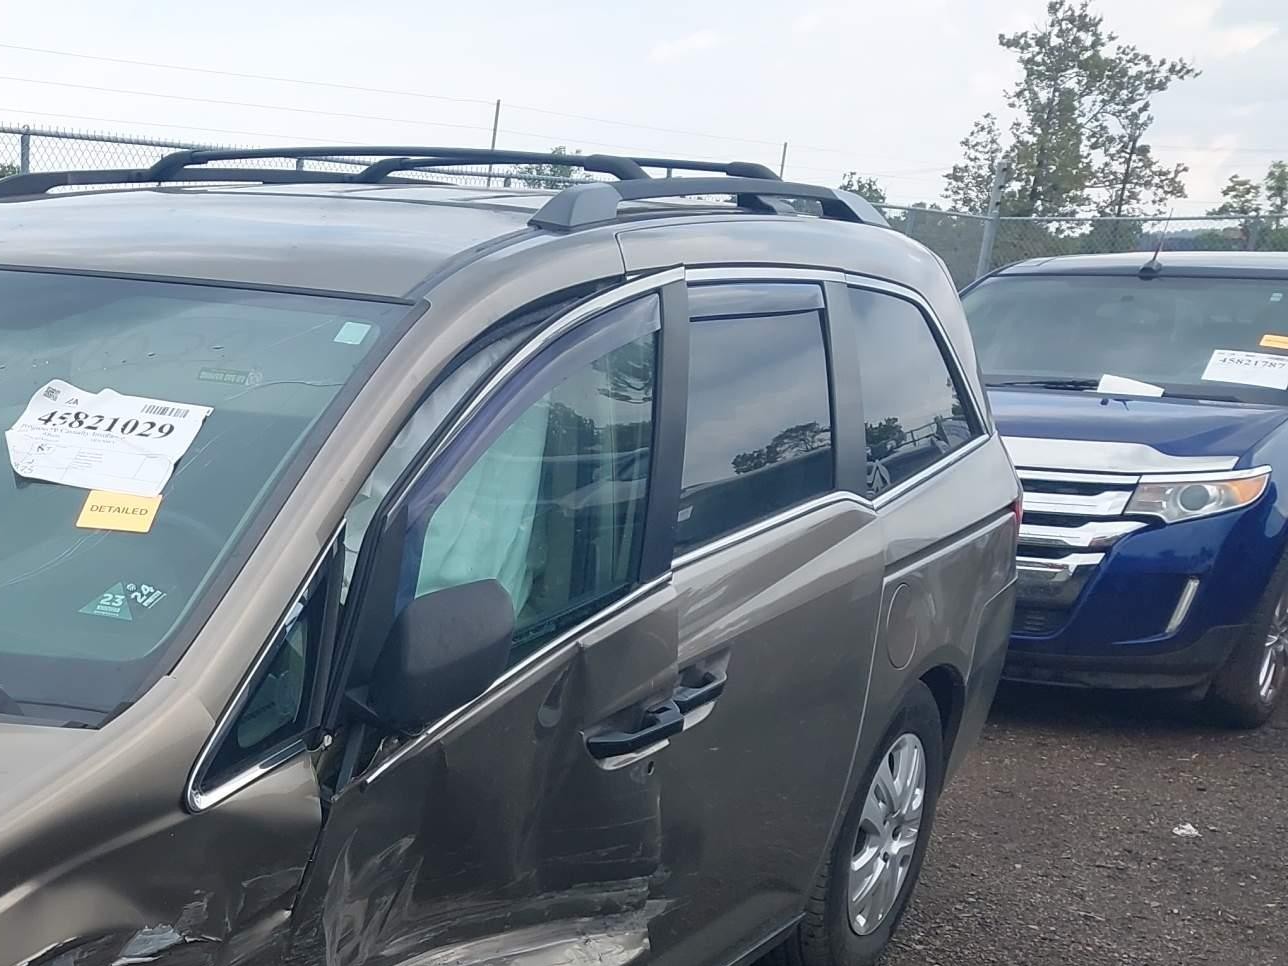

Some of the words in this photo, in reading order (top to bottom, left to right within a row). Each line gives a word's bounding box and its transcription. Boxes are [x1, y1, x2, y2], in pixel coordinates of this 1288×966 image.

[37, 409, 175, 439] 45821029
[89, 503, 149, 517] DETAILED
[99, 593, 126, 607] 23
